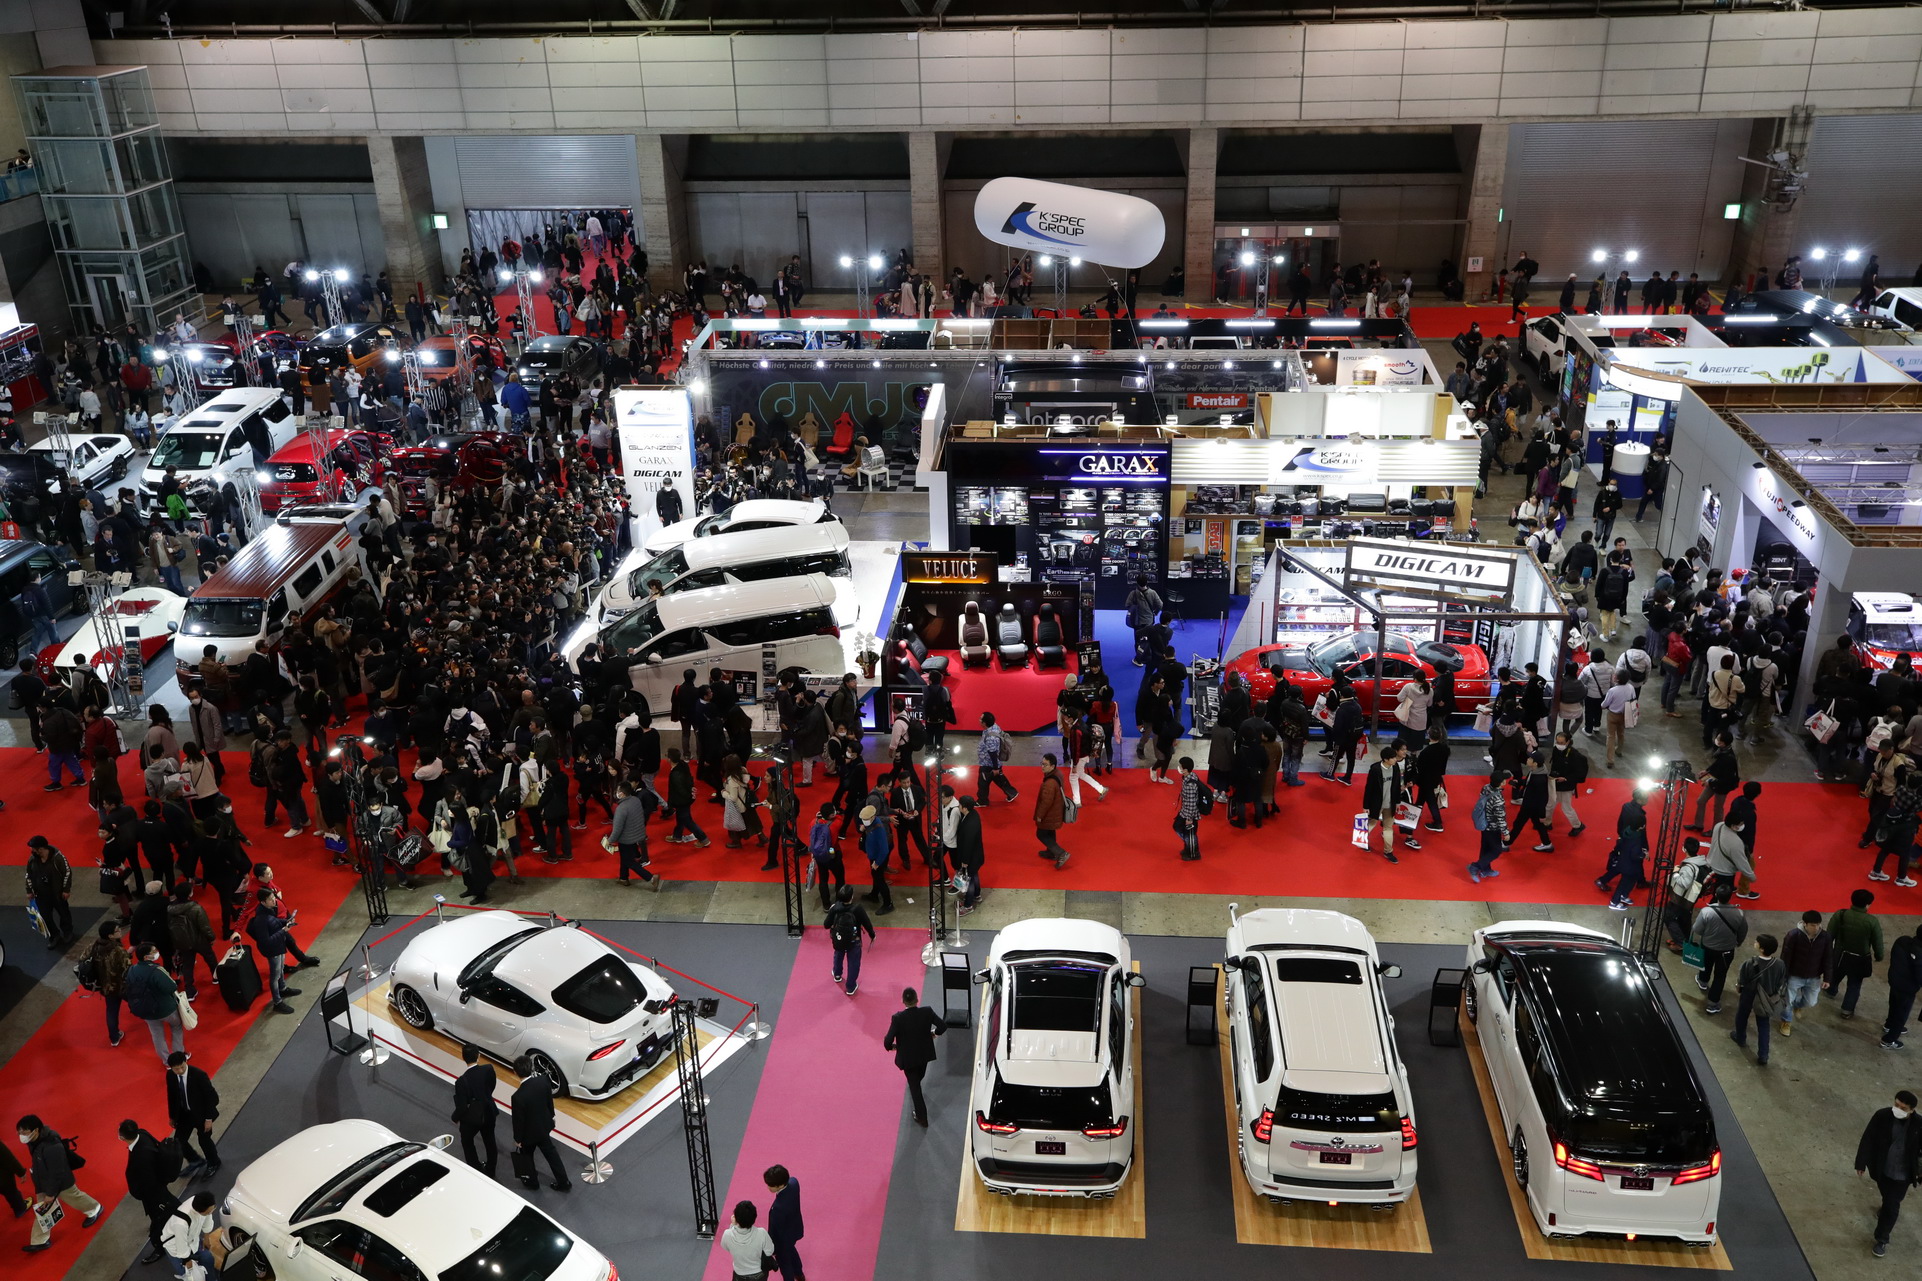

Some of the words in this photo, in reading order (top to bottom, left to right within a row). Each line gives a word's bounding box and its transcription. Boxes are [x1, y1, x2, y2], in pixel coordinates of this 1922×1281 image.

[1039, 211, 1086, 228] K'SPEC
[1038, 221, 1085, 237] GROUP
[1192, 396, 1240, 407] Pentair
[639, 456, 673, 465] GARAX
[1079, 455, 1159, 473] GARAX
[633, 470, 682, 478] DIGICAM
[922, 560, 978, 579] VELUCE
[1374, 553, 1485, 578] DIGICAM
